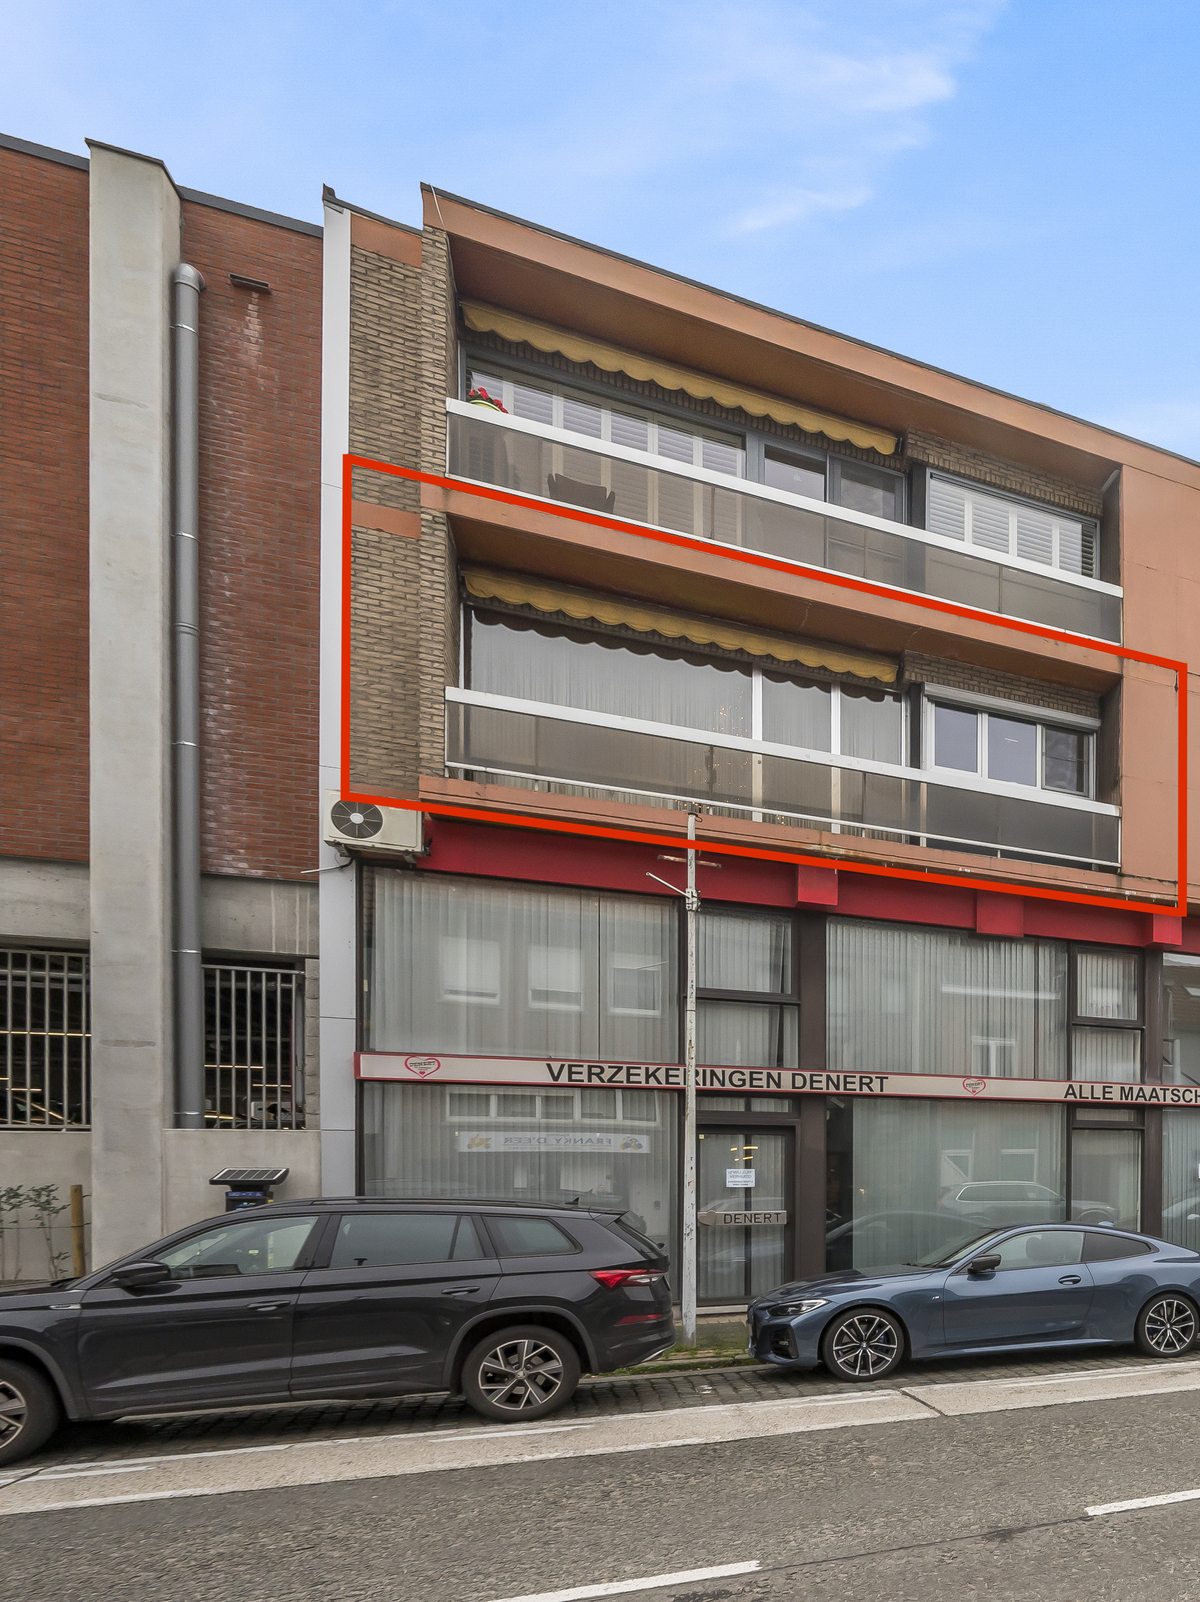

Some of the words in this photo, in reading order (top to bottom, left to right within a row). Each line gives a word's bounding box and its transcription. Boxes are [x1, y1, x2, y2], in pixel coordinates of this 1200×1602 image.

[546, 1062, 782, 1089] VERZEKERINGEN
[791, 1073, 889, 1093] DENERT
[1063, 1084, 1114, 1101] ALLE
[723, 1213, 782, 1224] DENERT
